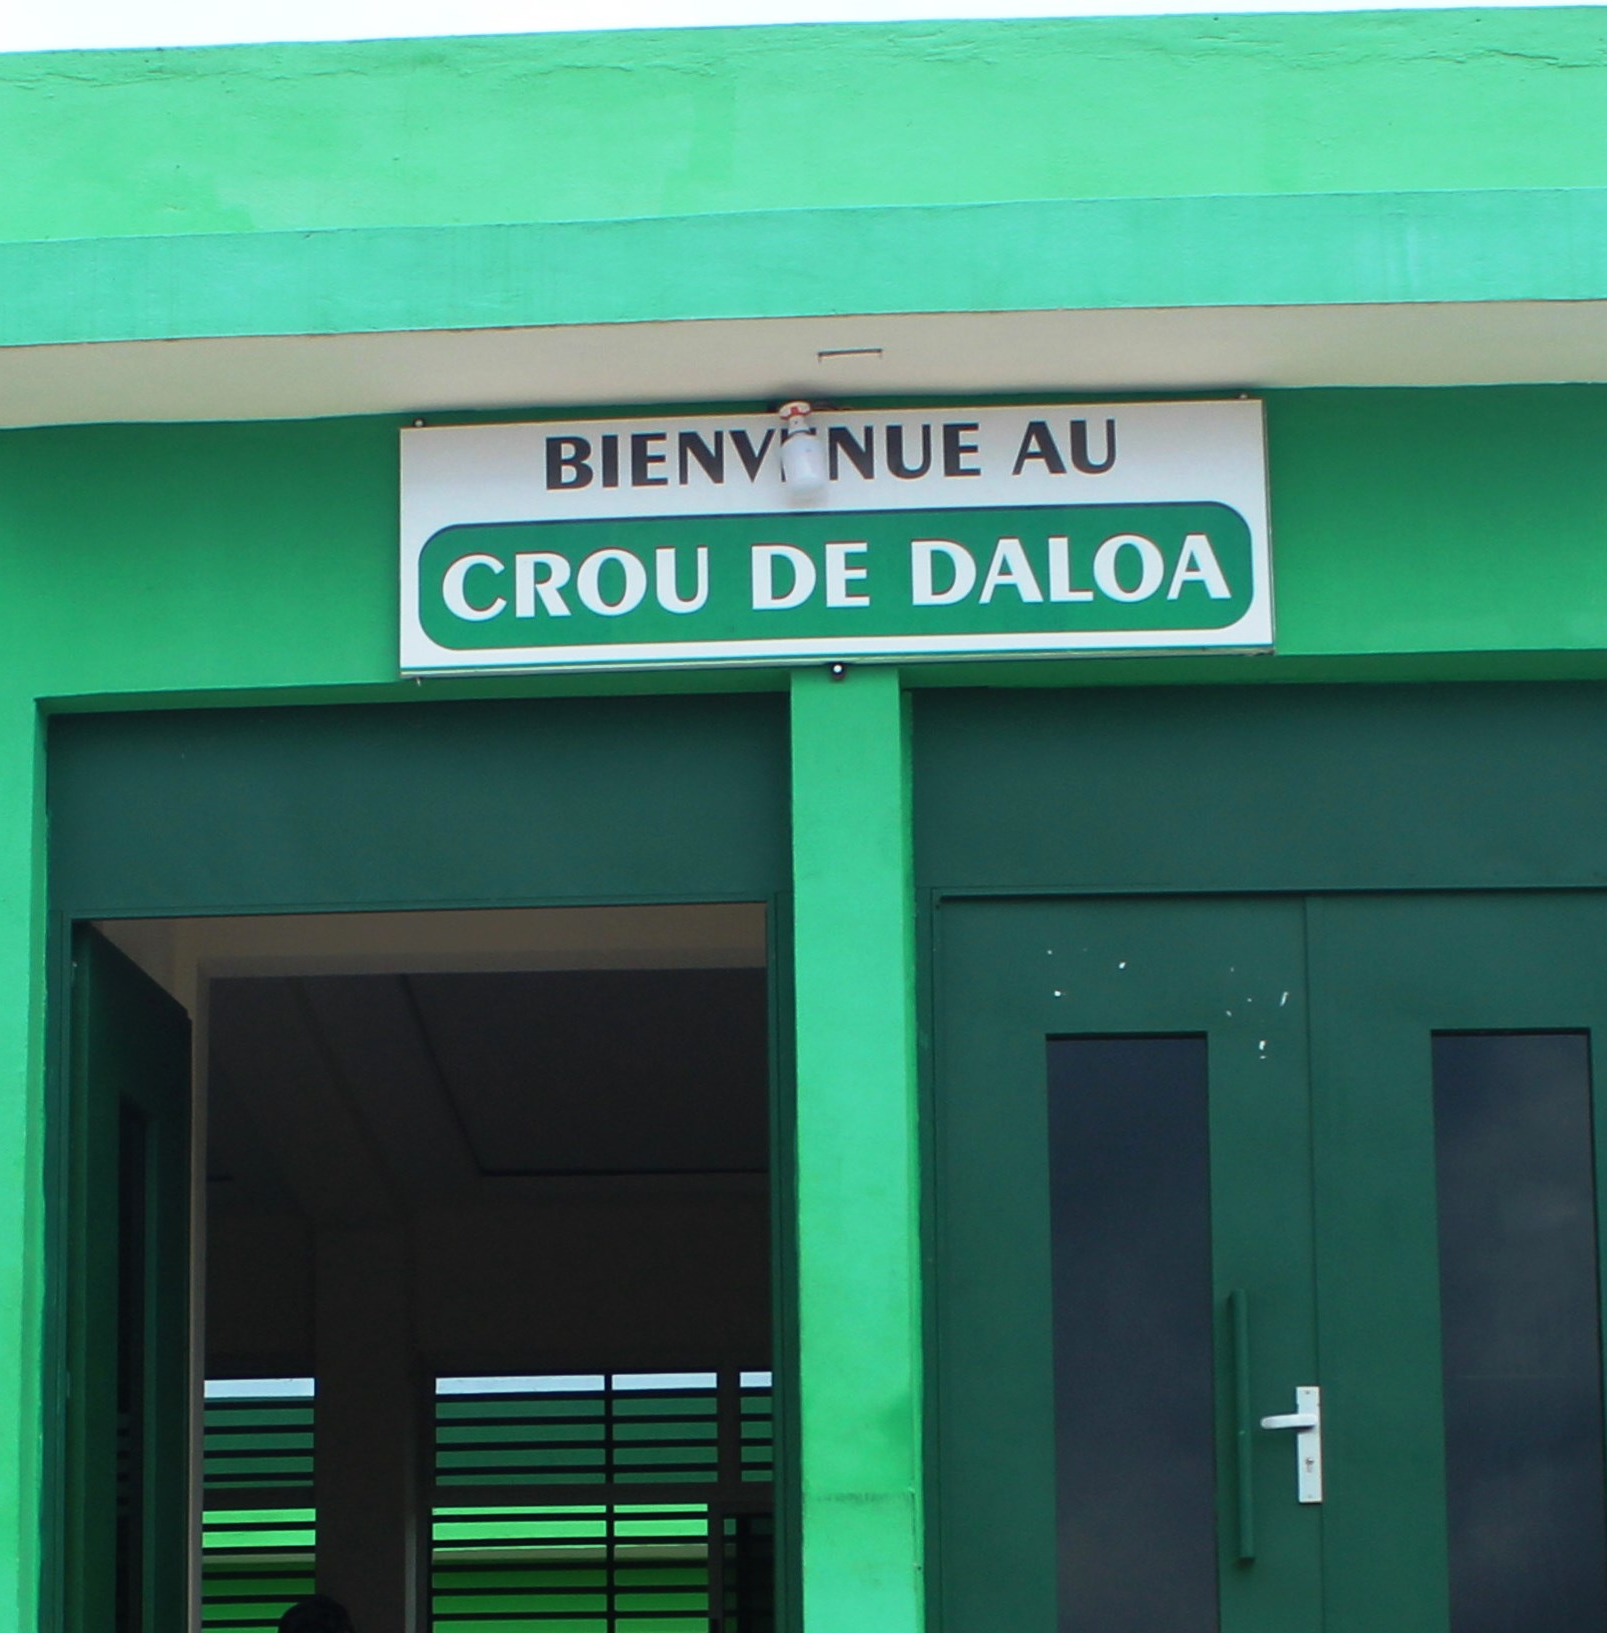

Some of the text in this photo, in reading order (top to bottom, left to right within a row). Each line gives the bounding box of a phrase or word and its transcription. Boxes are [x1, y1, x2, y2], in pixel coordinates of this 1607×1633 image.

[545, 419, 1116, 490] BIENVNUE AU
[441, 533, 1232, 621] CROU DE DALOA
